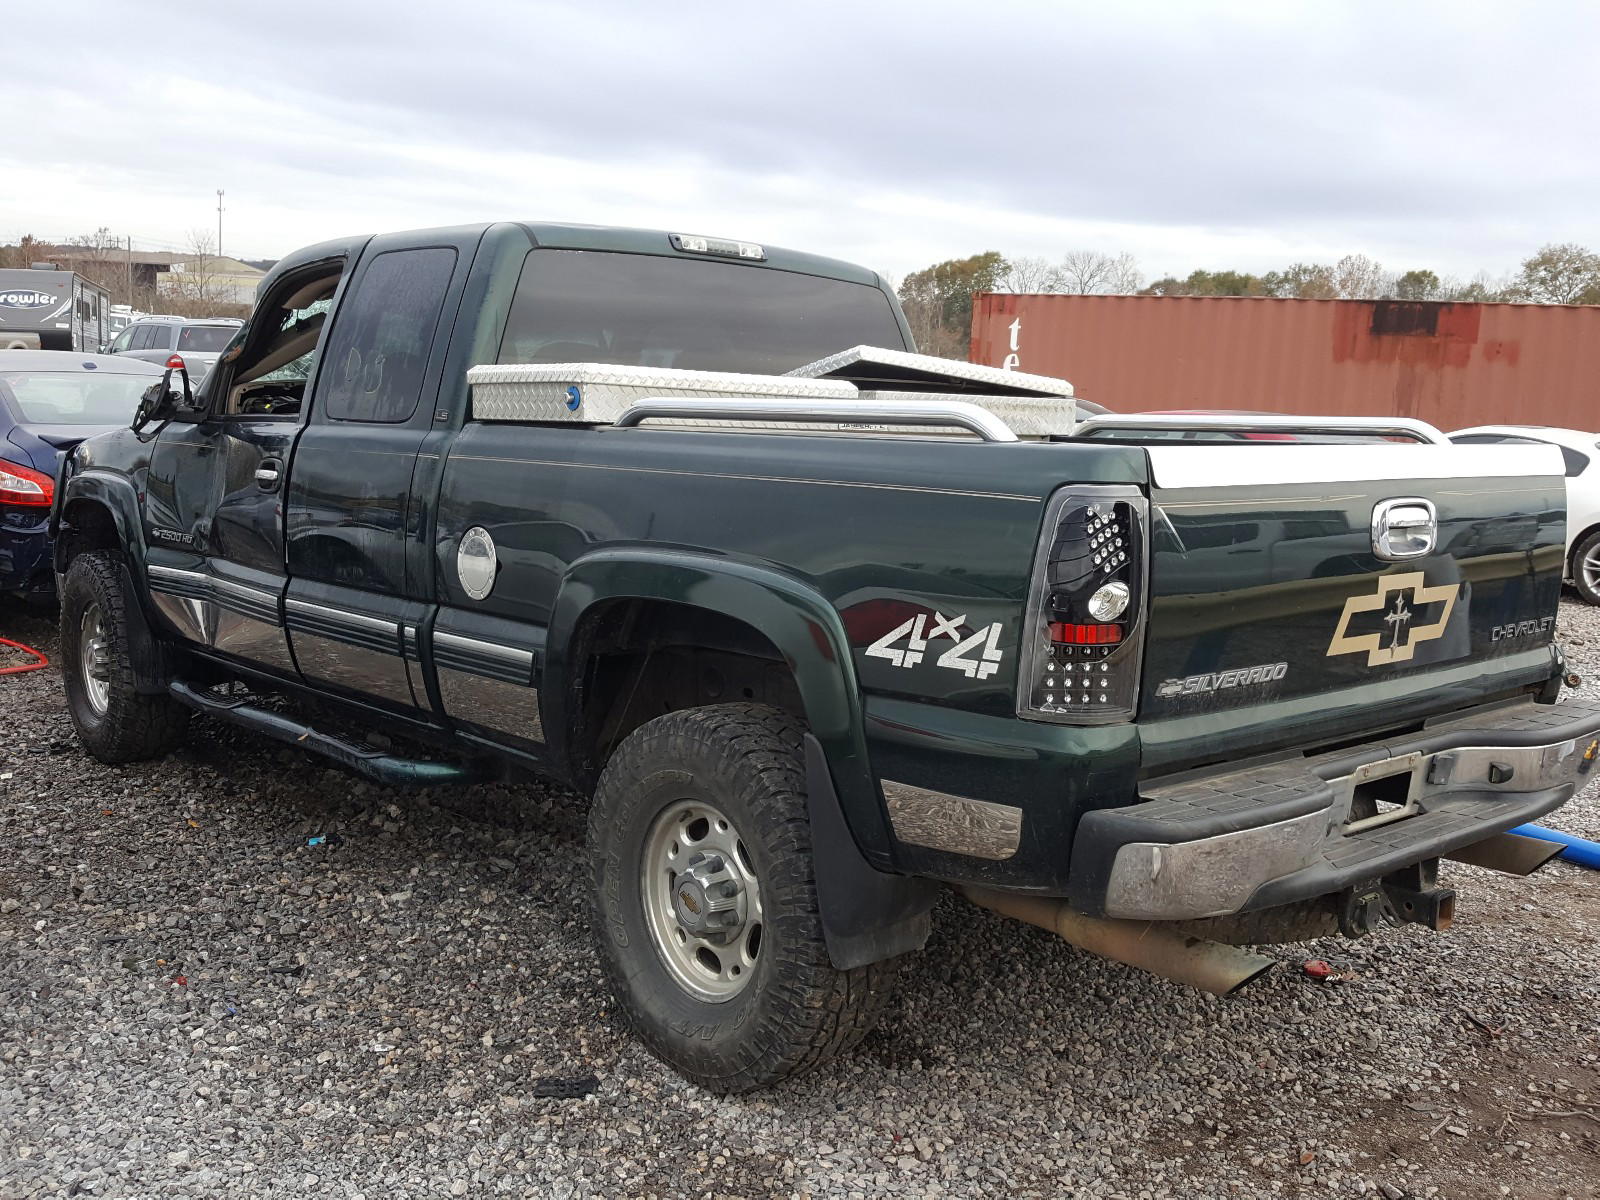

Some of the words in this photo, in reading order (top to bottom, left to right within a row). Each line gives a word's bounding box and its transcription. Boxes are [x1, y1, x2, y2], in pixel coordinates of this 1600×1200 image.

[160, 529, 182, 542] 2500
[1491, 616, 1554, 641] CHEVROLET
[1181, 661, 1288, 695] SILVERADO
